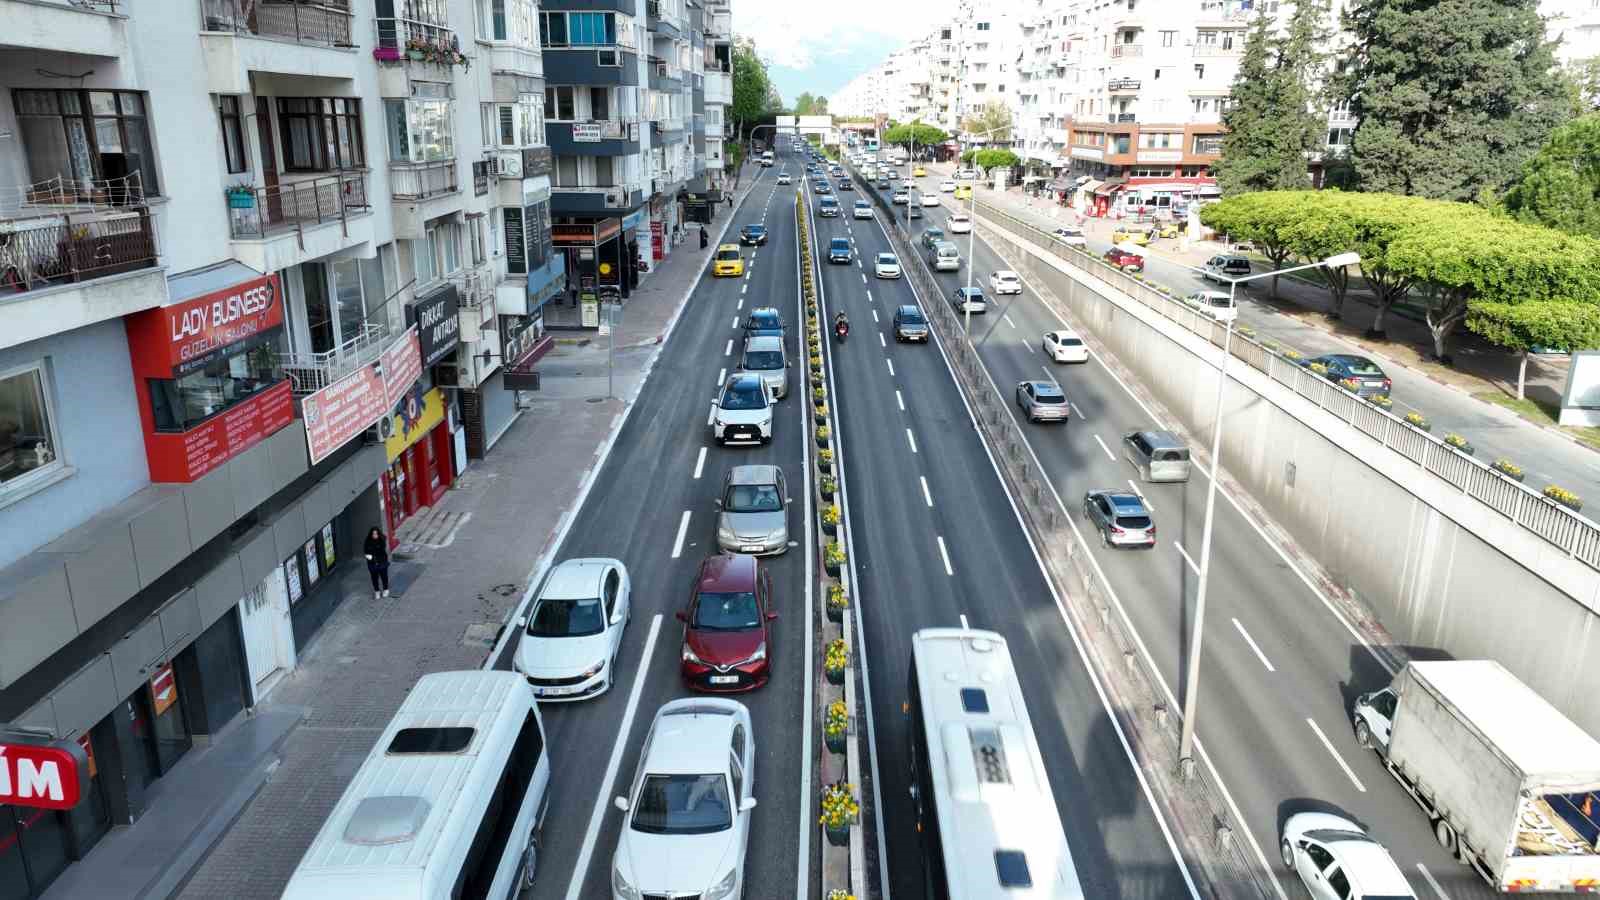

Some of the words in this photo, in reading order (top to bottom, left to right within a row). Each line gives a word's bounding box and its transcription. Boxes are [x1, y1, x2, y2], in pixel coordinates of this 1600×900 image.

[172, 306, 209, 341] LADY
[212, 286, 266, 328] BUSINESS
[432, 315, 458, 344] ANTALYA
